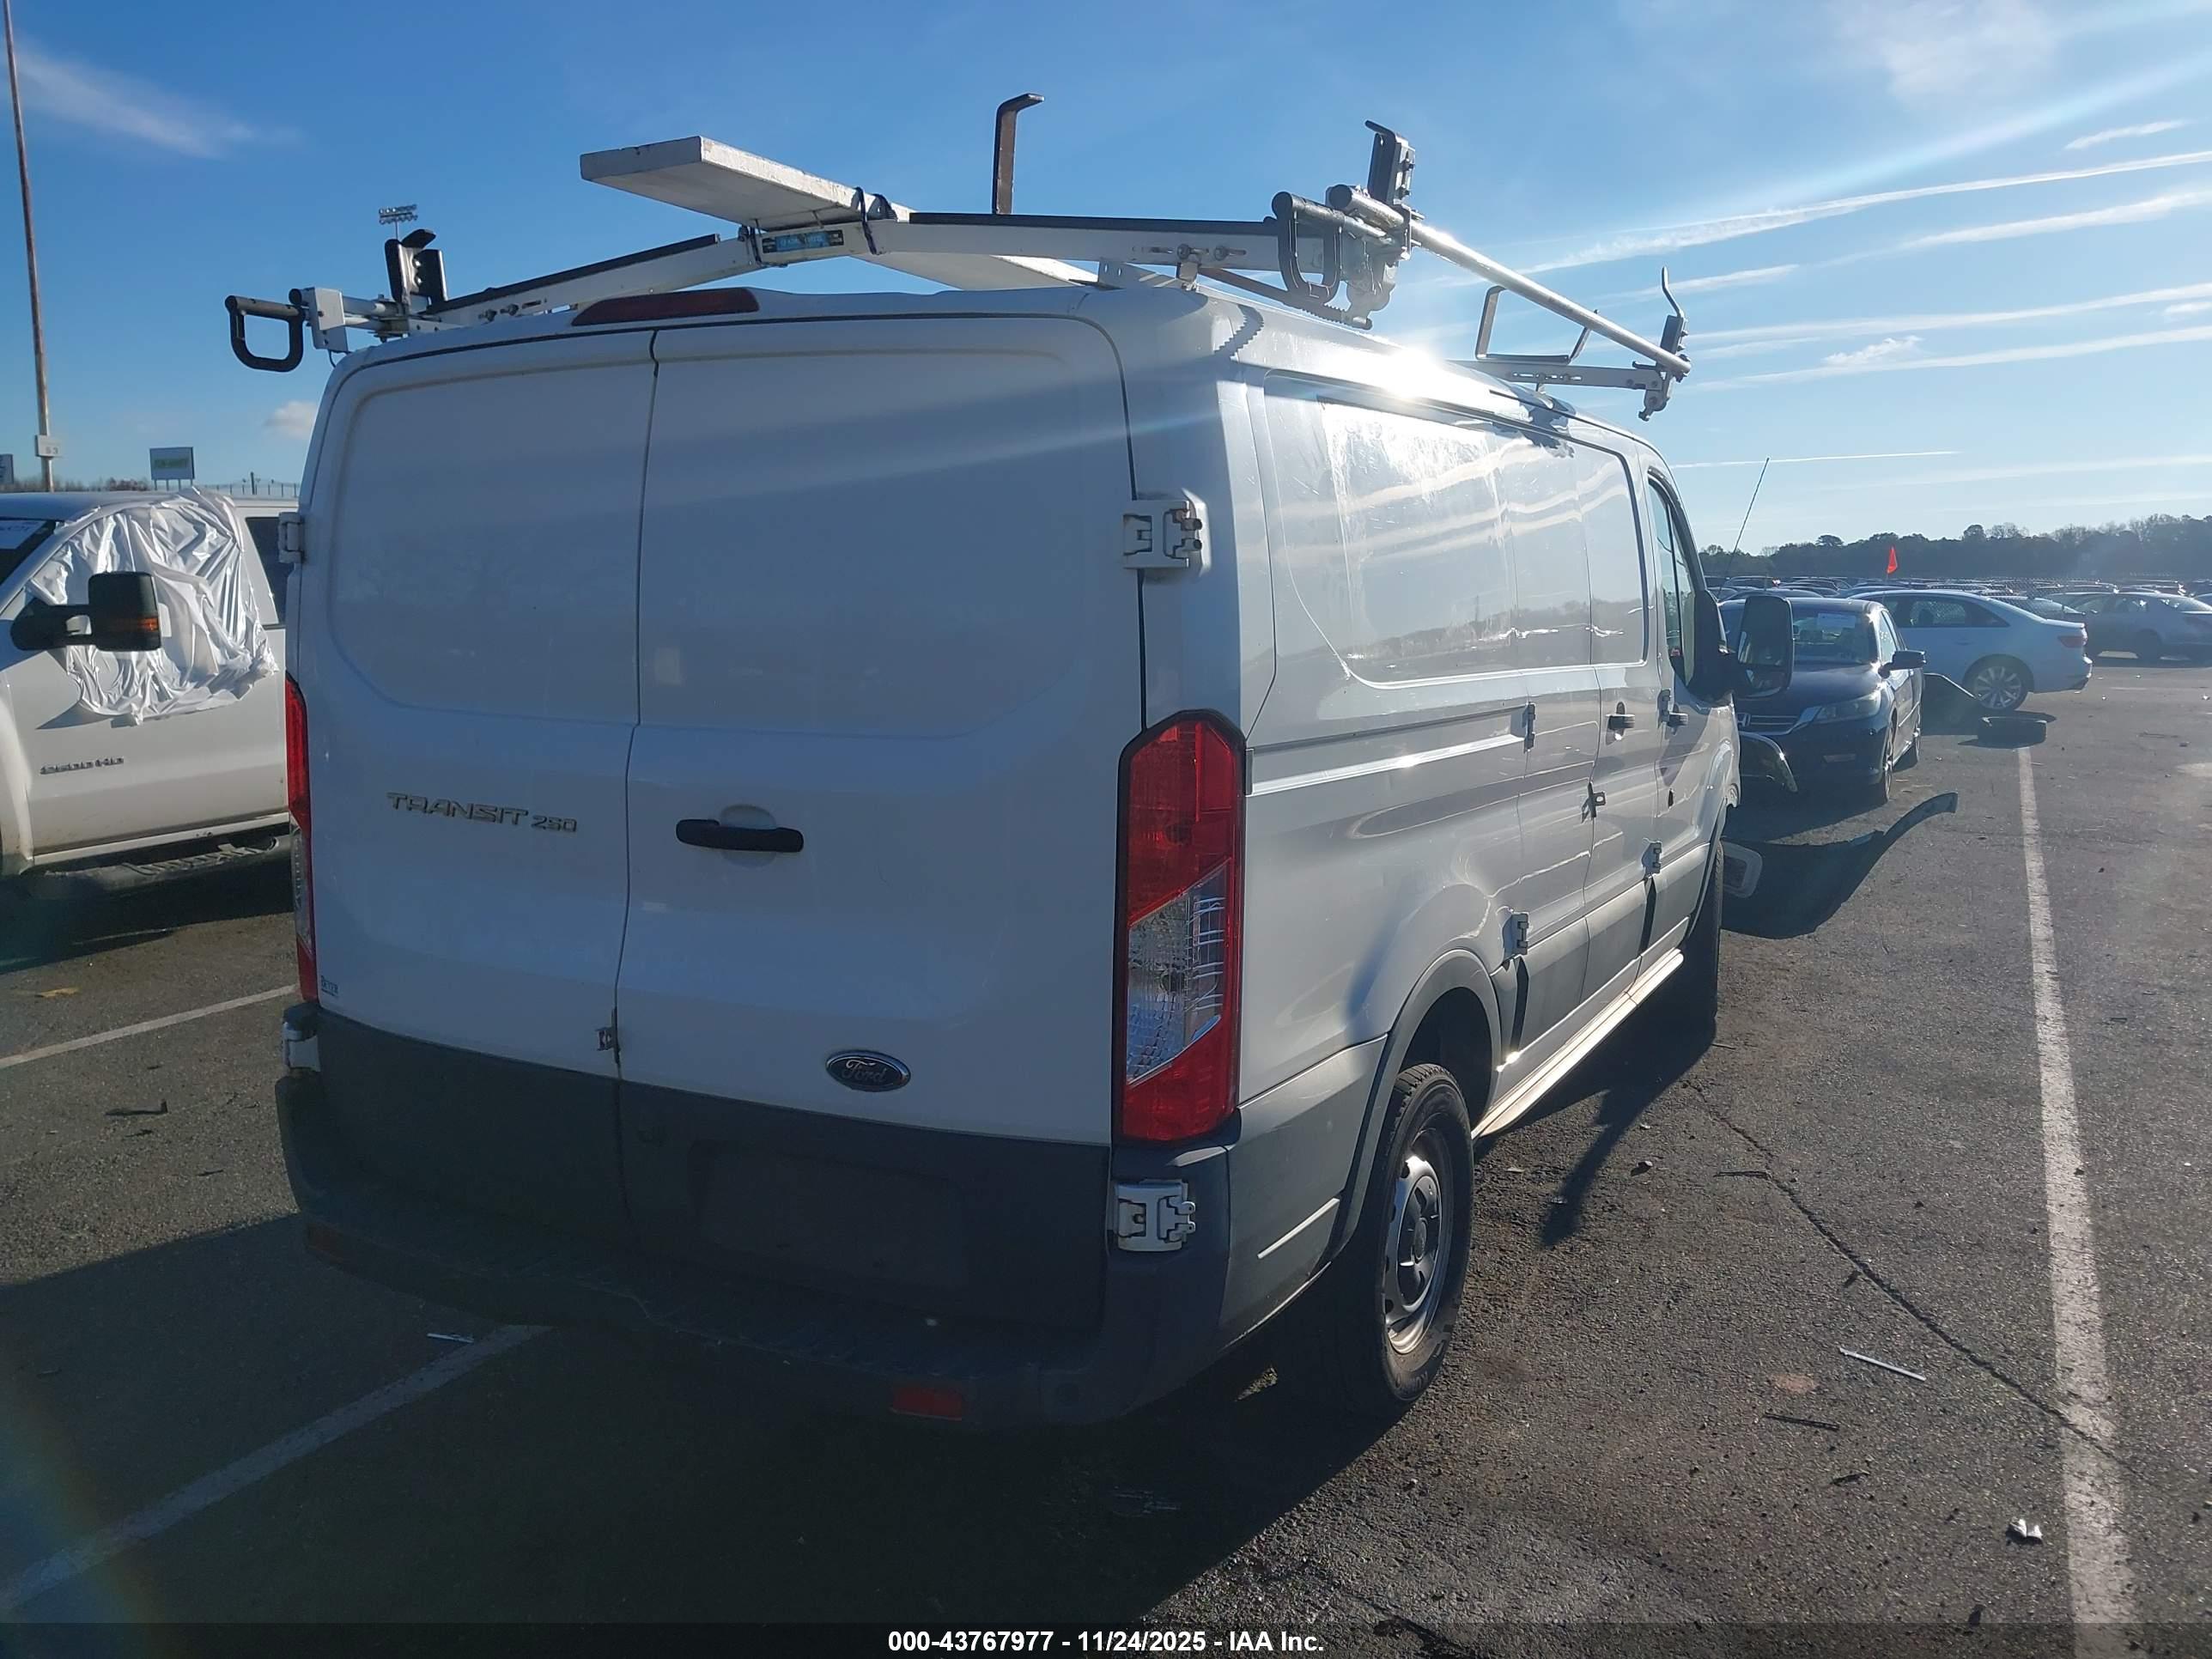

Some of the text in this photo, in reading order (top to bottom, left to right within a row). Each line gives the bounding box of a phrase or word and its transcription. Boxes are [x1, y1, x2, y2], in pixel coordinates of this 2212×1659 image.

[386, 792, 578, 833] TRANSIT 250
[841, 1059, 888, 1083] Ford
